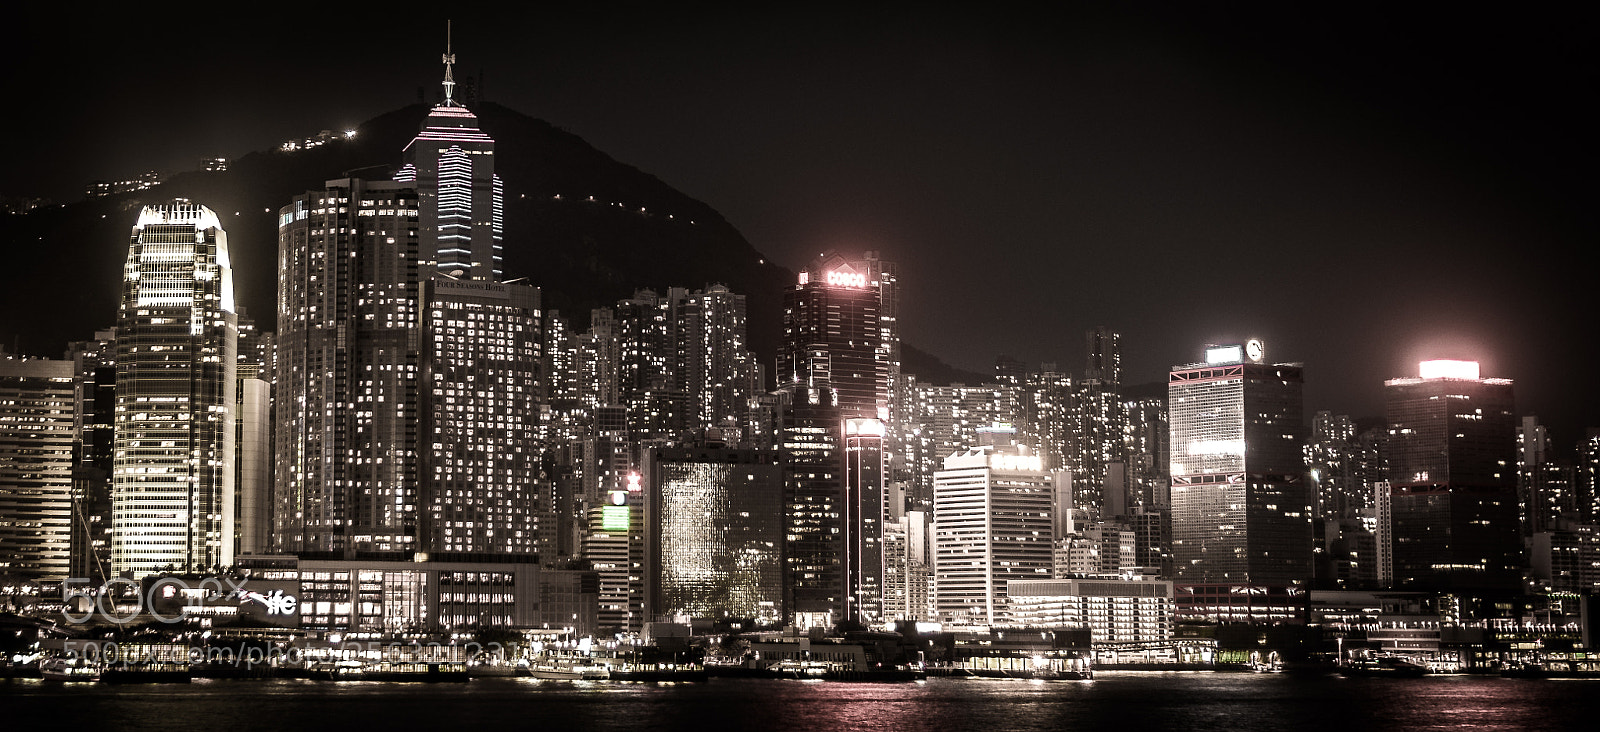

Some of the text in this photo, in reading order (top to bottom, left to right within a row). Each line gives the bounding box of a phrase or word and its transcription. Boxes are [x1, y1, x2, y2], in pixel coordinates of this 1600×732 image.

[436, 280, 506, 292] FOUR SEASONS HOTEL
[827, 271, 866, 288] COSCO
